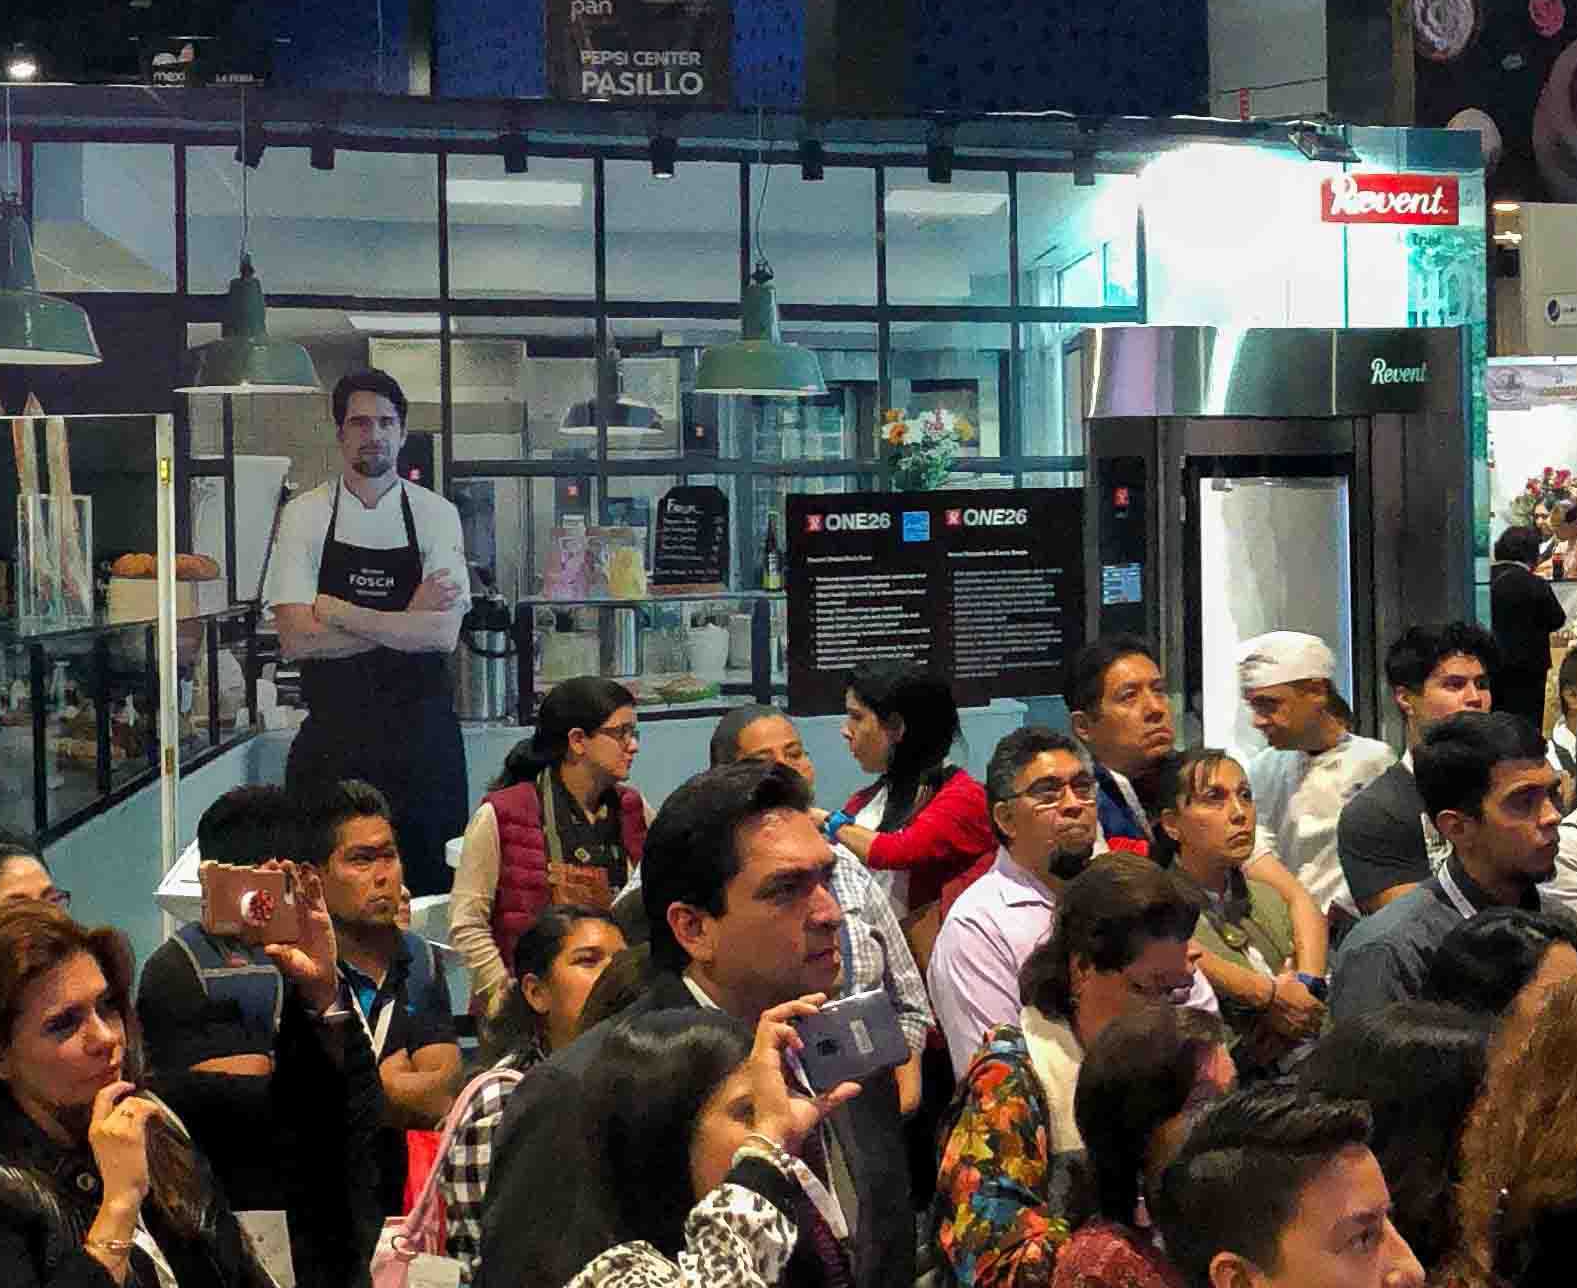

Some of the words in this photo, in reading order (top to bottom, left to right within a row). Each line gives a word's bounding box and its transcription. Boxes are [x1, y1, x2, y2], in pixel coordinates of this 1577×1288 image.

[580, 49, 630, 66] PEPSI
[632, 49, 702, 67] CENTER
[581, 70, 705, 97] PASILLO
[1330, 175, 1444, 215] Revent
[1370, 357, 1427, 385] Revent
[824, 512, 891, 531] ONE26
[963, 508, 1027, 526] ONE26
